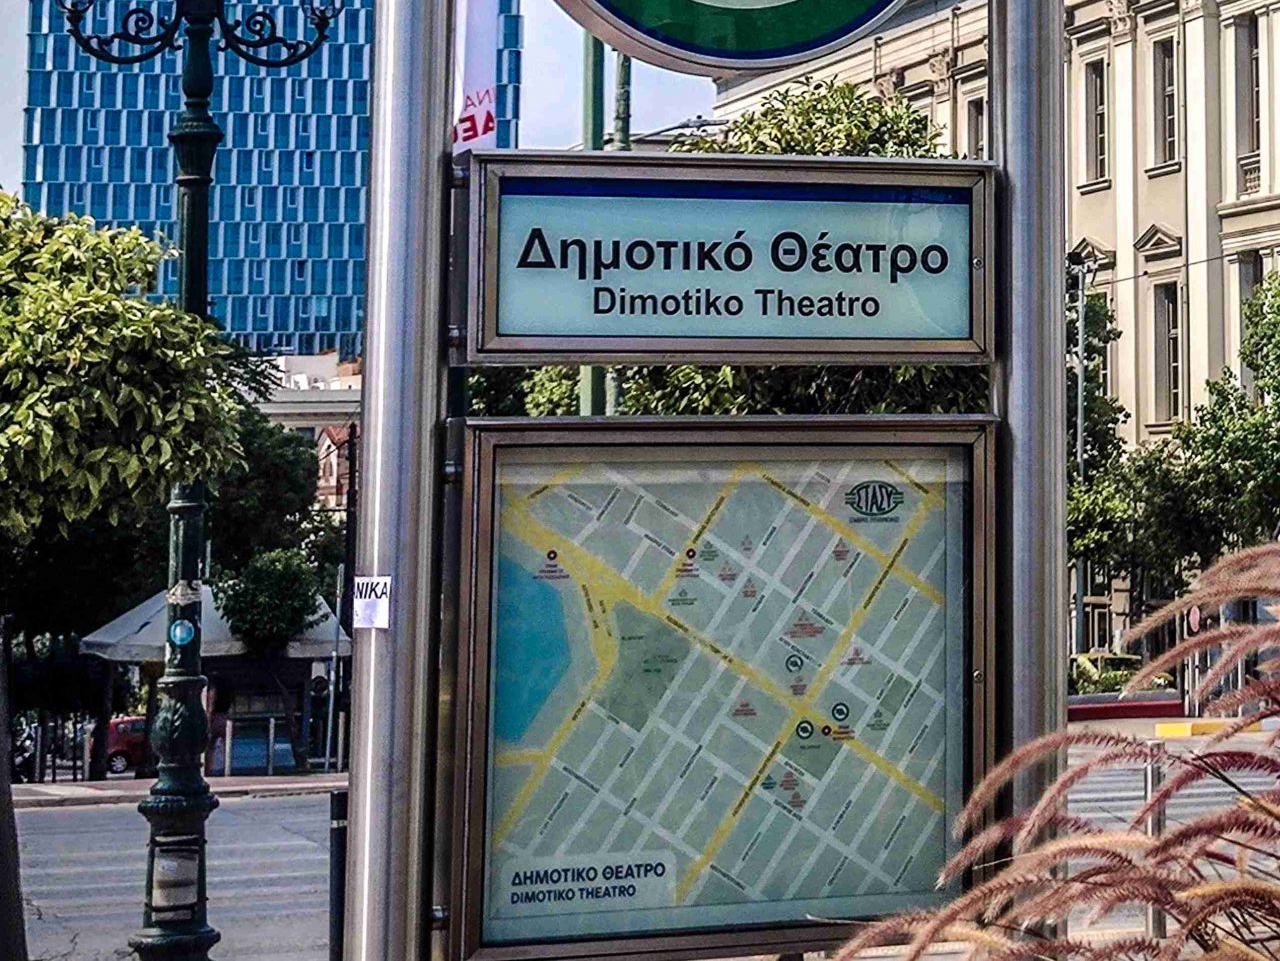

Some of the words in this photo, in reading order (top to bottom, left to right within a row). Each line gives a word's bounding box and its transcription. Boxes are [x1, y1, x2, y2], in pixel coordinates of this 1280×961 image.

[516, 227, 753, 280] Δημοτικό
[770, 231, 949, 283] Θέατρο
[593, 287, 744, 317] Dimotiko
[755, 289, 881, 318] Theatro
[511, 868, 598, 887] ΔΗΜΟΤΙΚΟ
[602, 862, 666, 881] ΘΕΑΤΡΟ
[511, 887, 576, 905] DIMOTIKO
[578, 884, 637, 900] THEATRO
